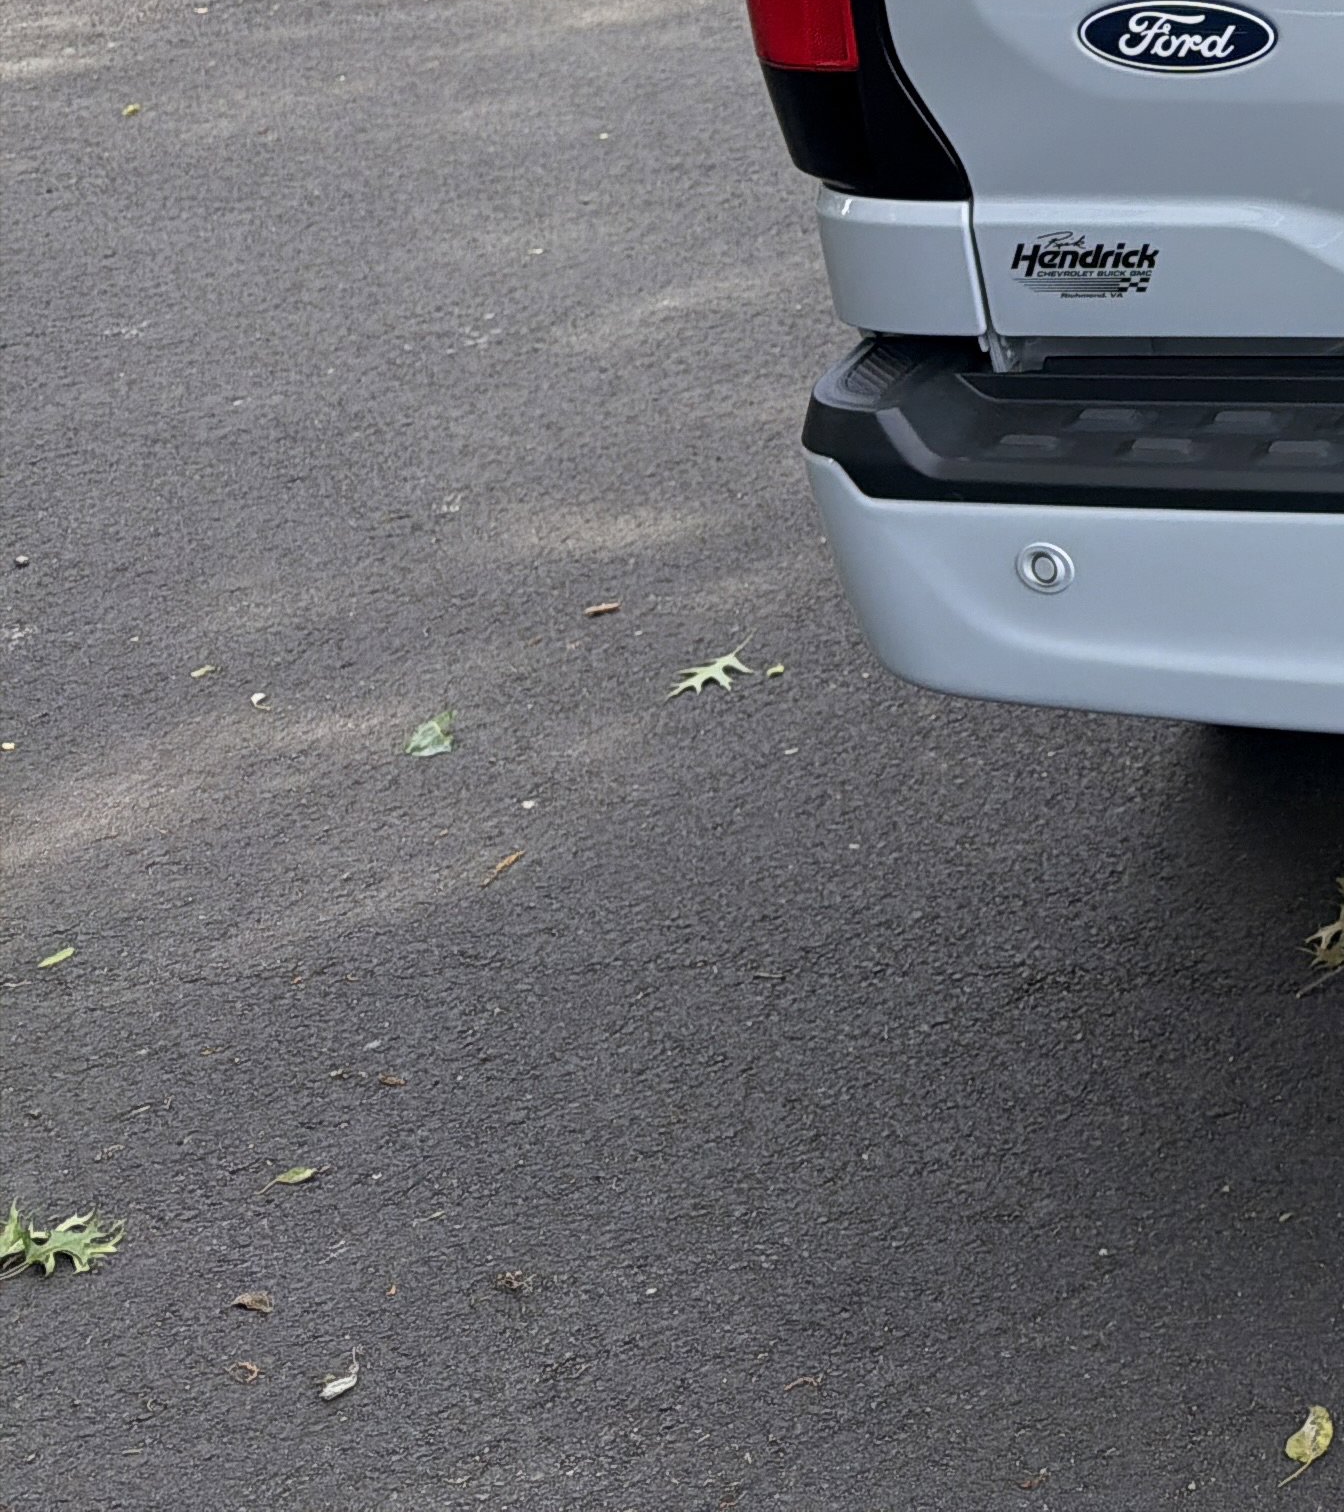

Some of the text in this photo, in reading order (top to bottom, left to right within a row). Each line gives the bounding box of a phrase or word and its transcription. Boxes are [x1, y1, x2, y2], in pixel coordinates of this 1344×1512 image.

[1118, 11, 1237, 58] Ford
[1010, 242, 1160, 278] Hendrick
[1036, 270, 1094, 278] CHEVROLET
